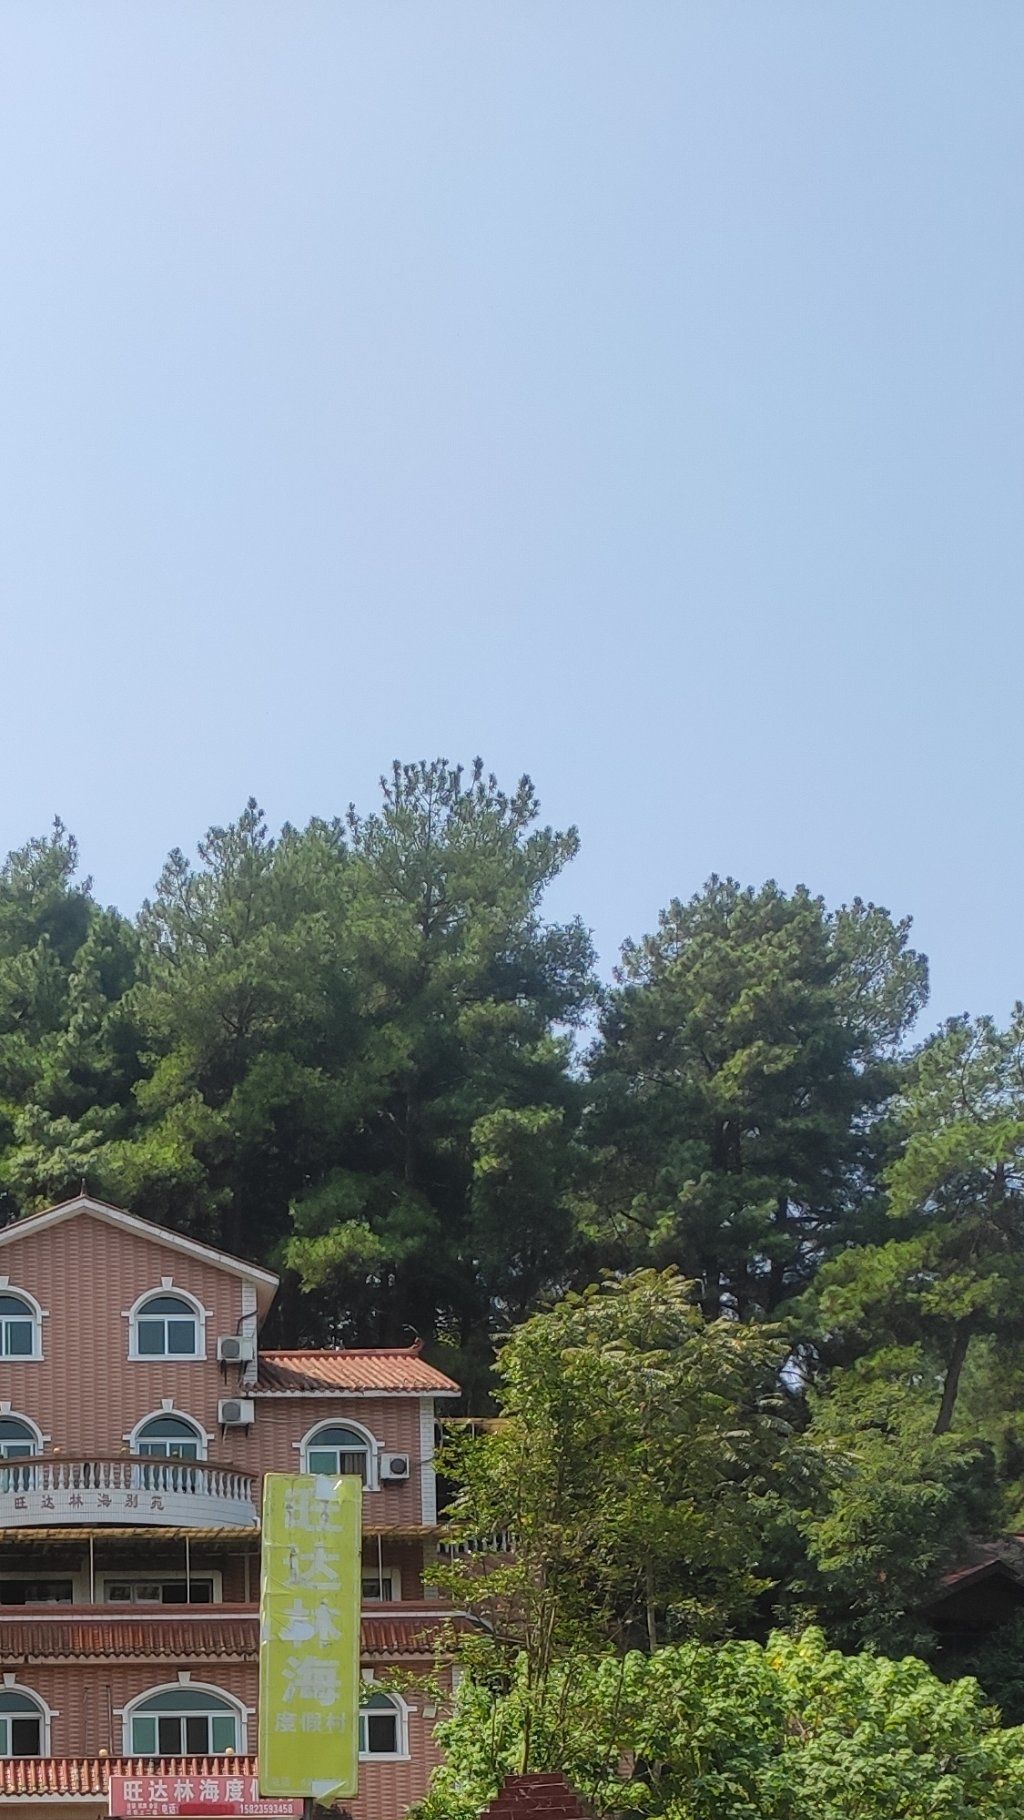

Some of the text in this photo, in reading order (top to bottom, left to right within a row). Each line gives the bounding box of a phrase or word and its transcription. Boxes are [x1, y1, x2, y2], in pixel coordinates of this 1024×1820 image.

[279, 1487, 344, 1706] 旺达林海
[275, 1712, 346, 1734] 度假村
[123, 1778, 294, 1802] 旺达林海度
[239, 1803, 294, 1814] 15823593458
